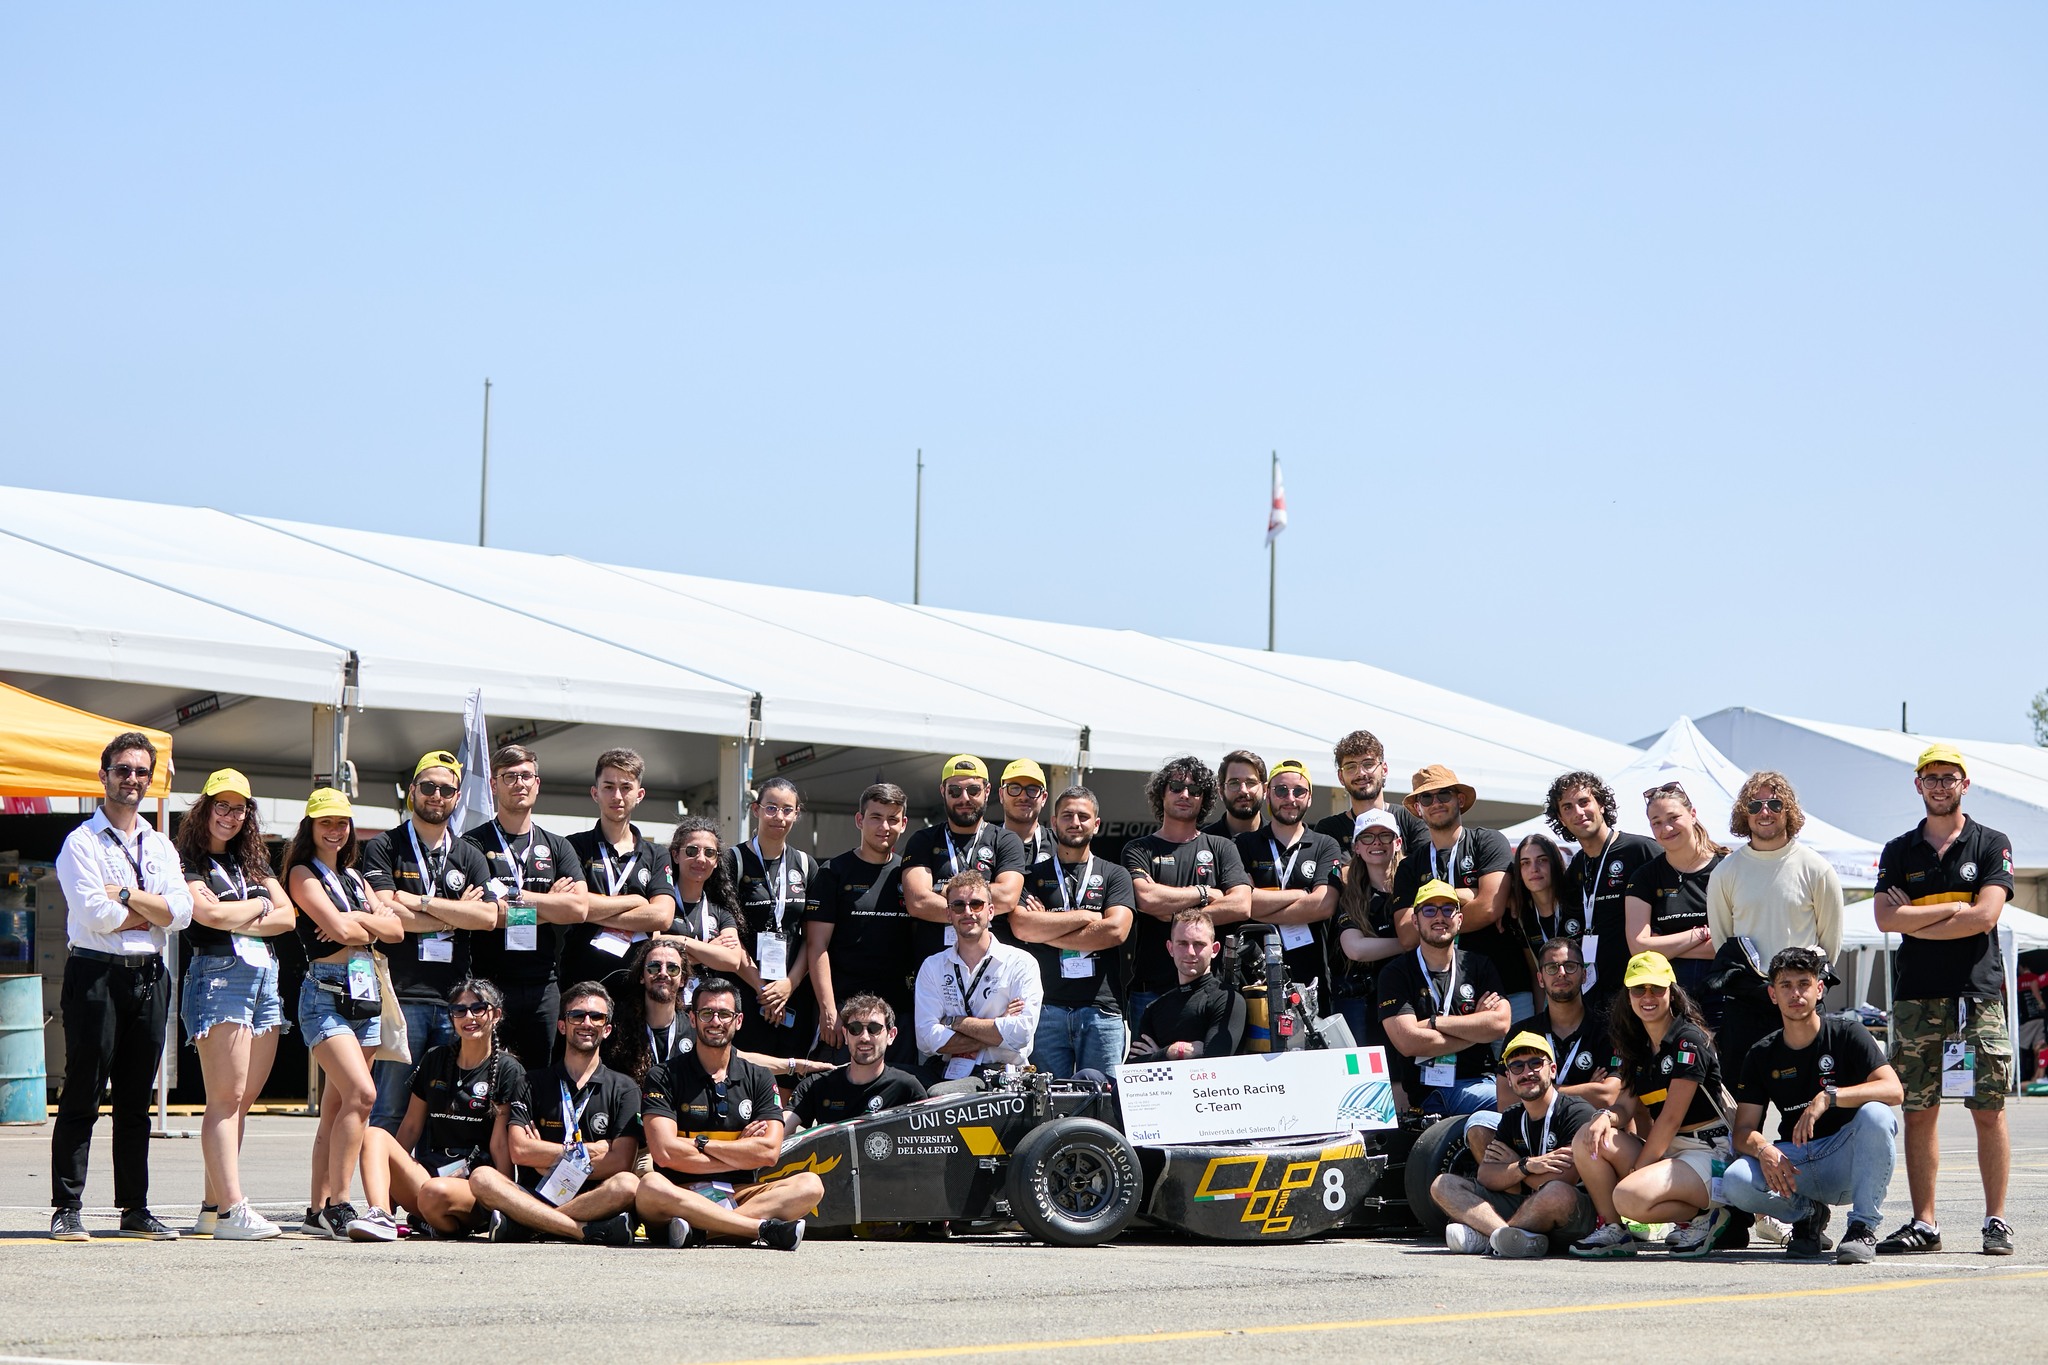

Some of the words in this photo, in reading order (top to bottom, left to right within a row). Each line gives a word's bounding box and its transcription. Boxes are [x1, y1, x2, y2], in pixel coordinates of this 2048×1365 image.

[1190, 1072, 1209, 1081] CAR
[1211, 1071, 1217, 1079] 8
[1192, 1086, 1240, 1099] Salento
[1243, 1083, 1286, 1095] Racing
[909, 1115, 940, 1131] UNI
[945, 1097, 1025, 1125] SALENTO
[1195, 1102, 1242, 1113] C-Team
[1132, 1130, 1161, 1141] Saleri
[1199, 1127, 1235, 1136] Università
[1249, 1125, 1276, 1134] Salento
[897, 1135, 953, 1144] UNIVERSITA'
[897, 1147, 916, 1155] DEL
[917, 1145, 959, 1155] SALENTO
[1106, 1141, 1138, 1205] Hoosier
[1029, 1160, 1057, 1223] Hoosier
[1322, 1167, 1347, 1212] 8
[1275, 1189, 1292, 1217] SRT
